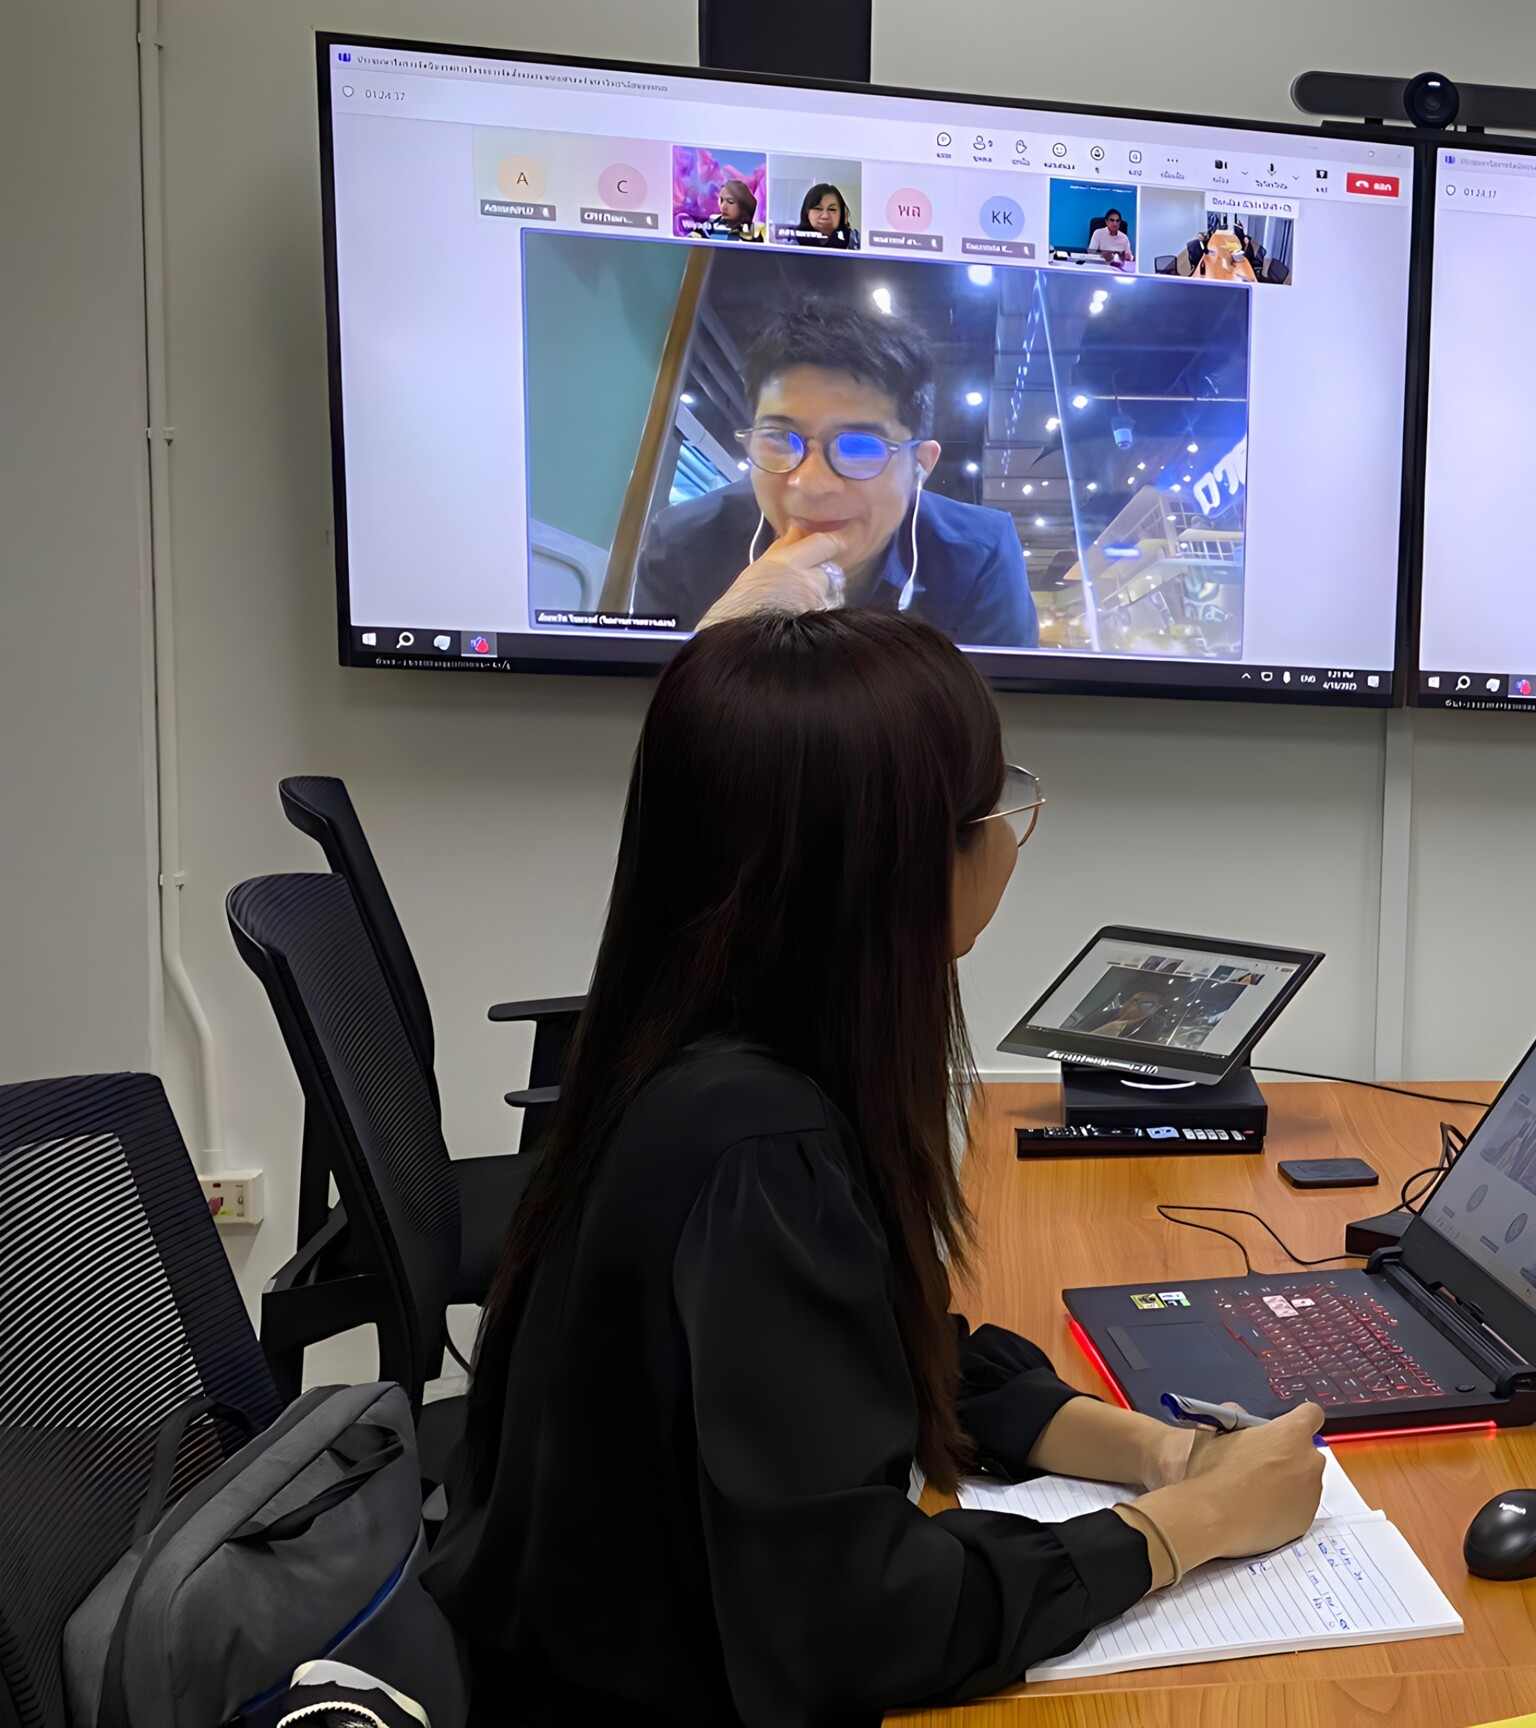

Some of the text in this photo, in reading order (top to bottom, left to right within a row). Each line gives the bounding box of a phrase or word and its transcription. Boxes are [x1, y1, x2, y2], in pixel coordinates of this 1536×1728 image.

[516, 172, 529, 186] A
[616, 180, 629, 194] C
[991, 210, 1013, 226] KK
